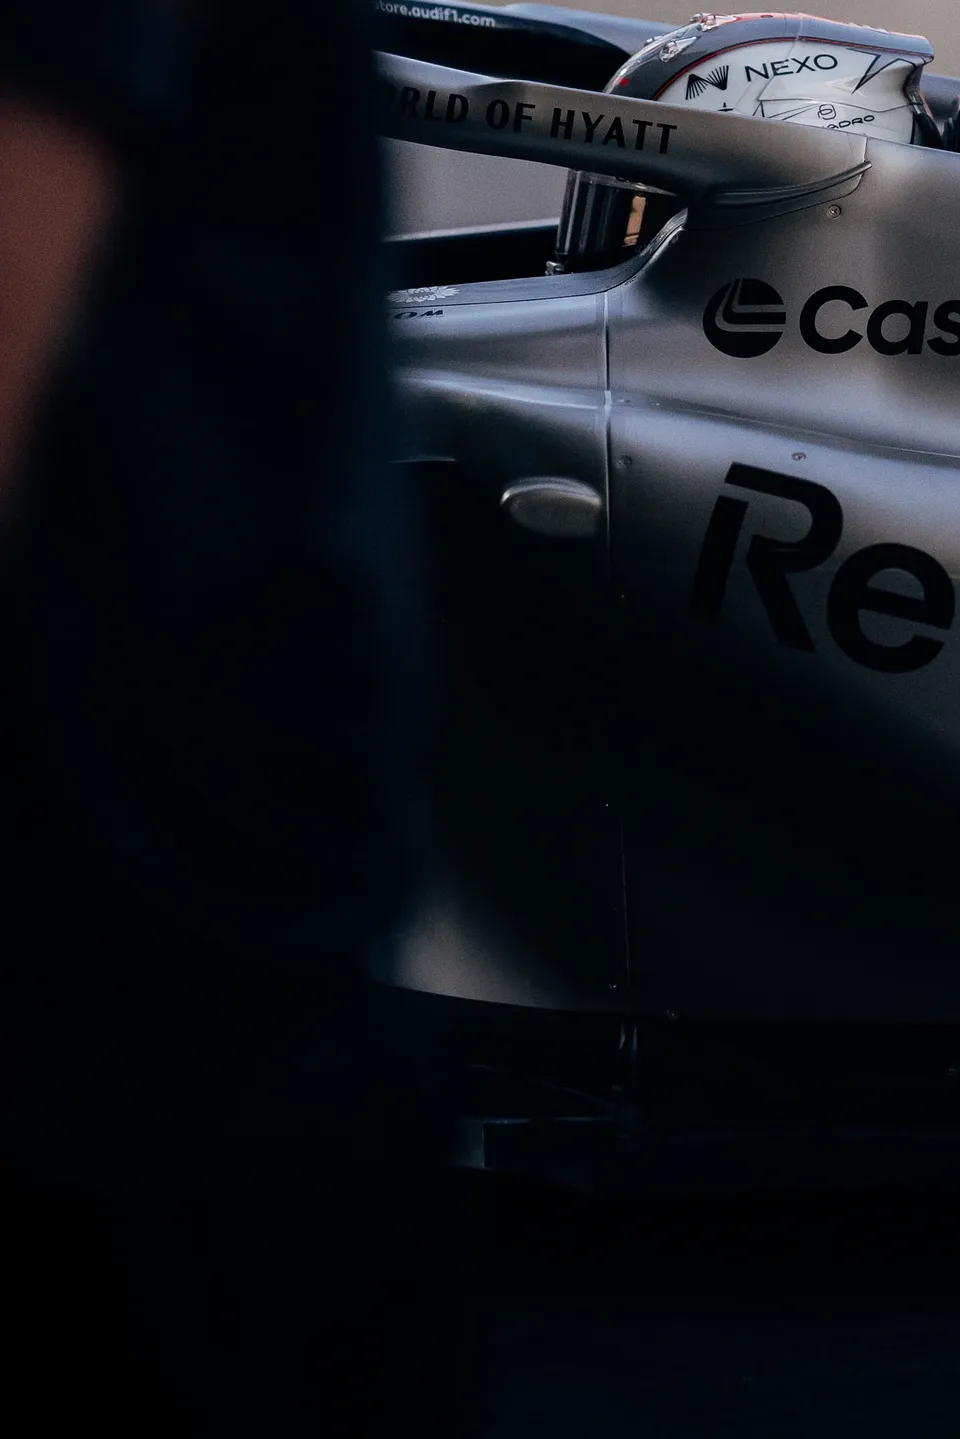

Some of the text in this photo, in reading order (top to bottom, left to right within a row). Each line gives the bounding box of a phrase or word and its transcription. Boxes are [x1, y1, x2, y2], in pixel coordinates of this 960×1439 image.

[745, 54, 838, 82] NEXO
[485, 99, 536, 133] OF
[550, 107, 678, 154] HYATT
